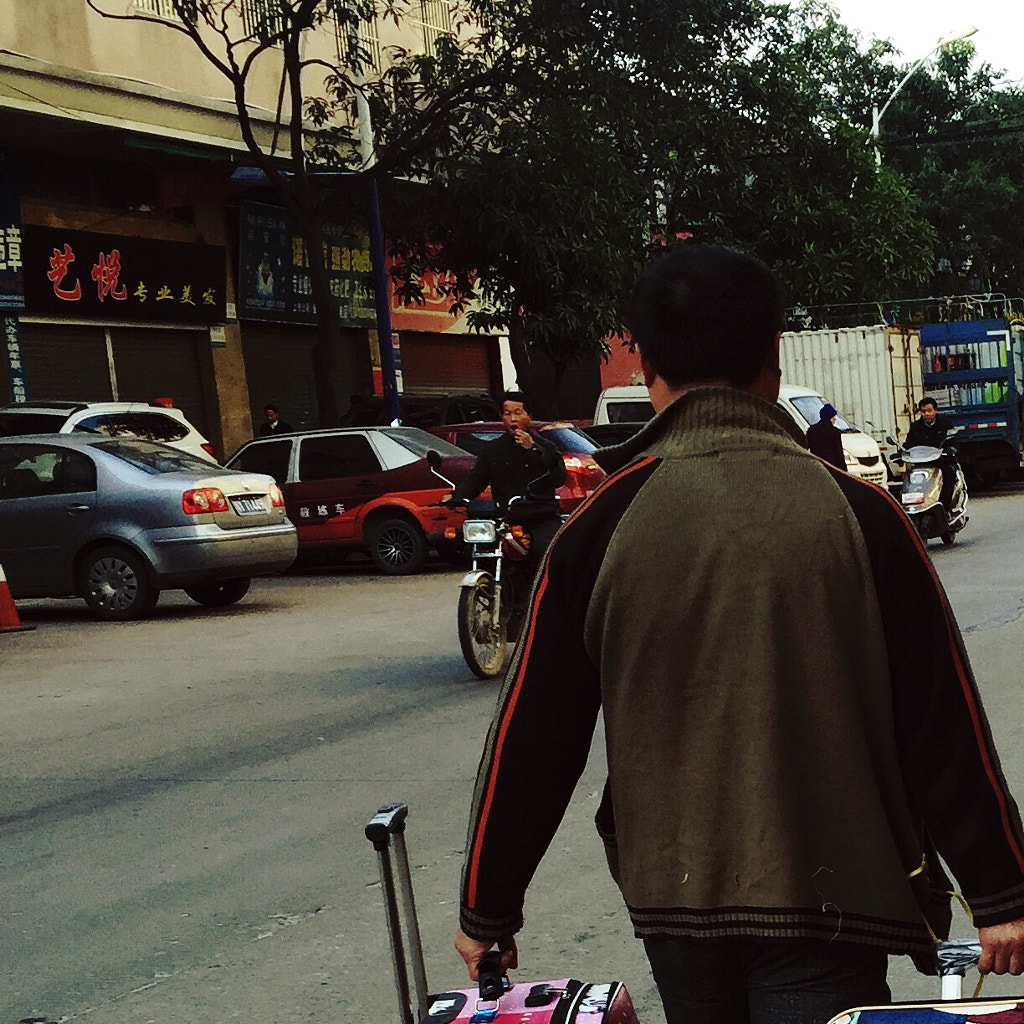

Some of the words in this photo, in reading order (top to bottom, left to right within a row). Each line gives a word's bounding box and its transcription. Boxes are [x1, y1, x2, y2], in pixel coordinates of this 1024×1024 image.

[47, 242, 128, 302] 艺悦
[133, 279, 218, 308] 专业美发
[299, 503, 345, 518] 教练车
